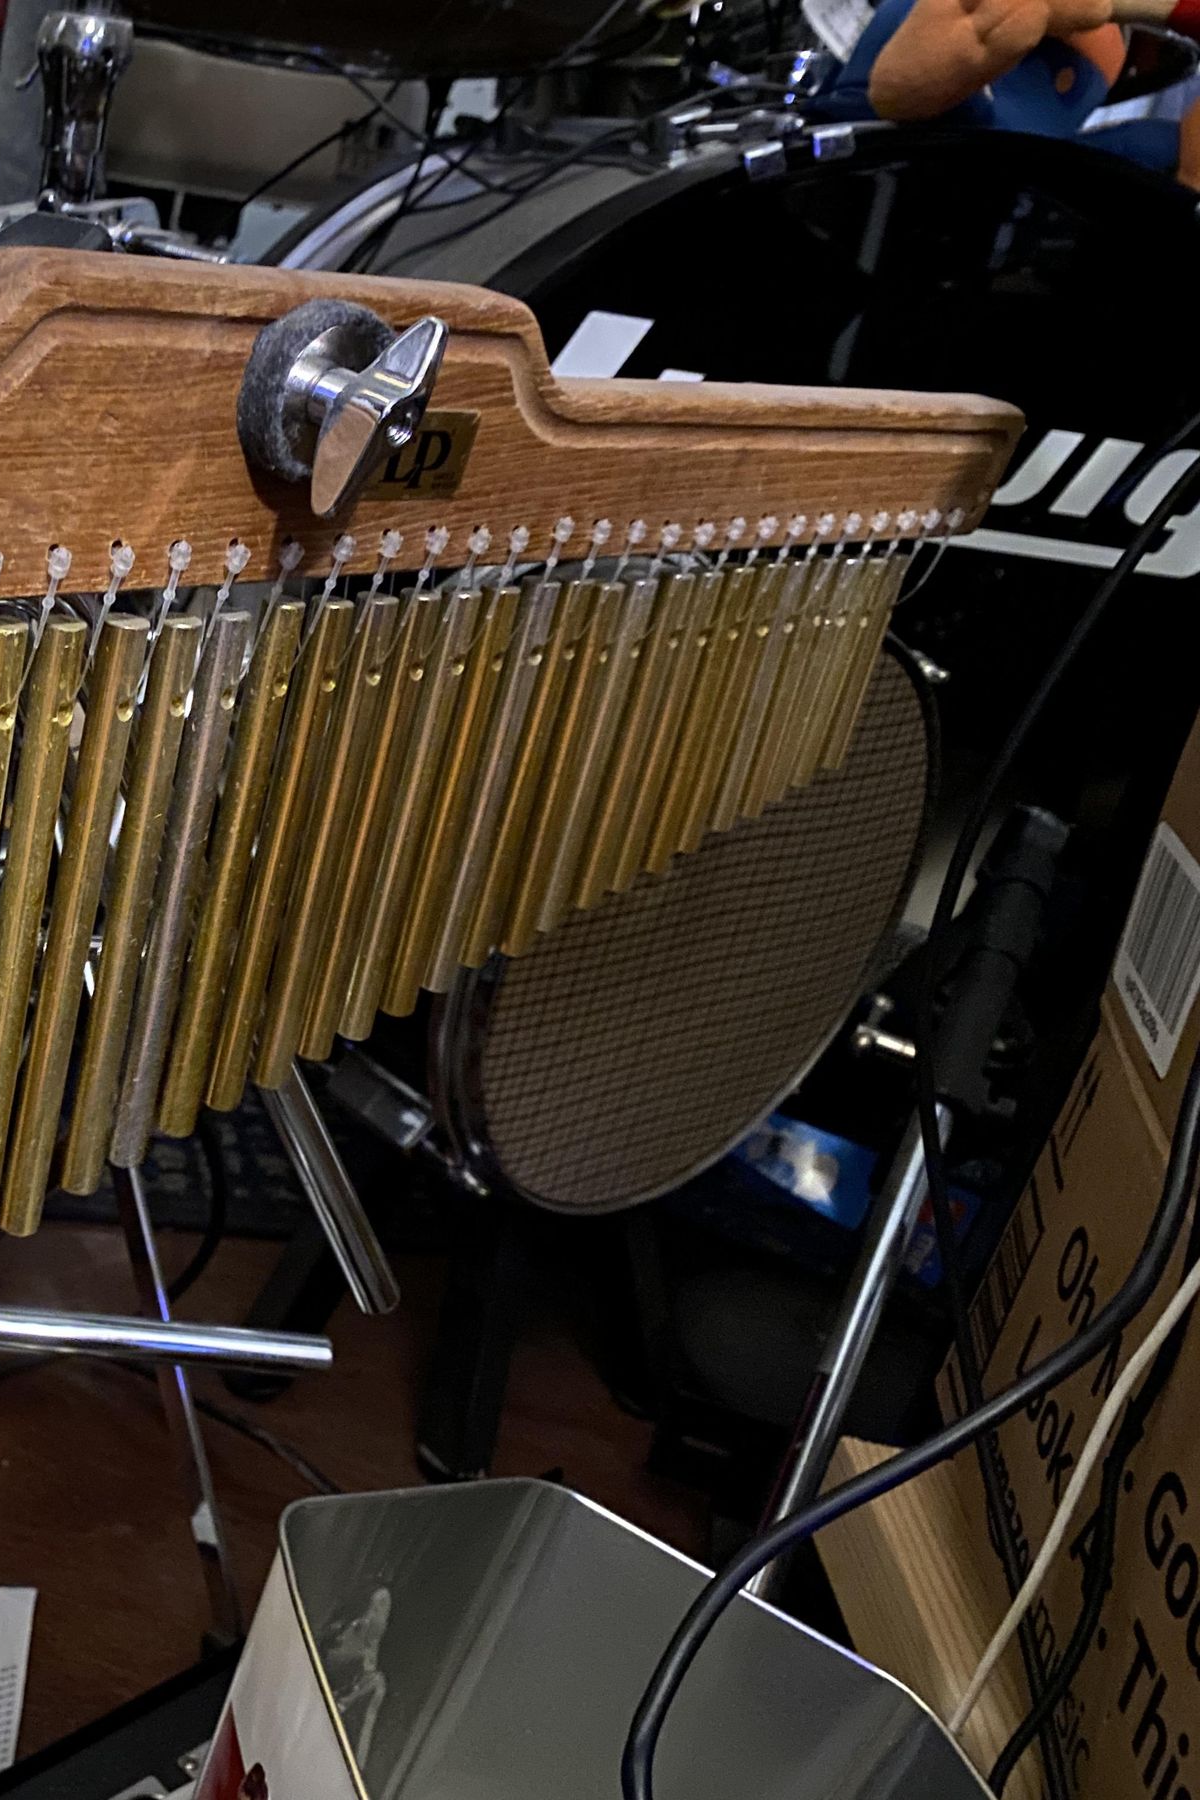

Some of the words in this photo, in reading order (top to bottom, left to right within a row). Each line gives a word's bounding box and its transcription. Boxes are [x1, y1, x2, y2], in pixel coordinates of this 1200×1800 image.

[379, 430, 452, 489] LP
[1057, 1226, 1099, 1337] Oh
[1118, 1618, 1198, 1800] Thi
